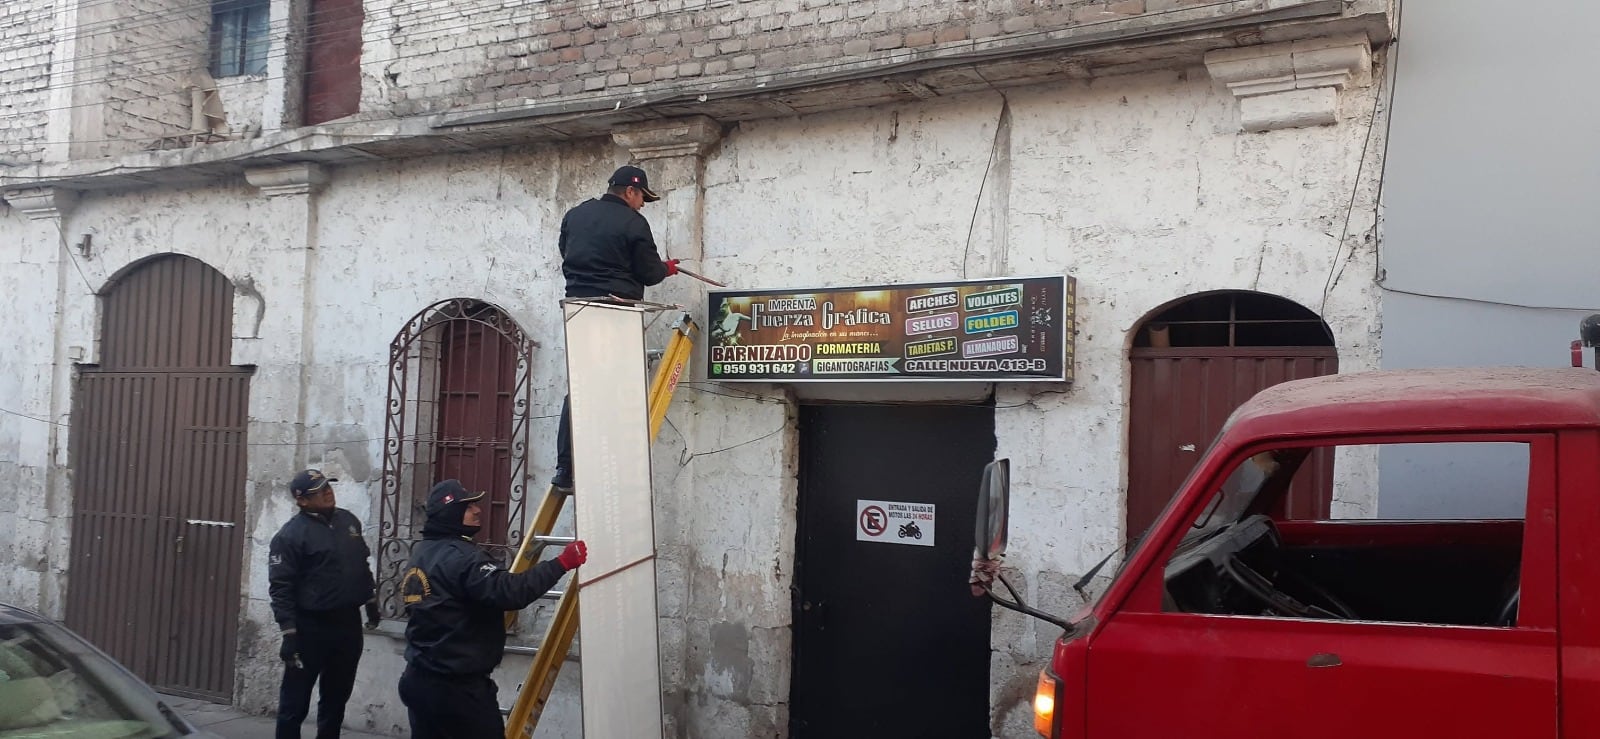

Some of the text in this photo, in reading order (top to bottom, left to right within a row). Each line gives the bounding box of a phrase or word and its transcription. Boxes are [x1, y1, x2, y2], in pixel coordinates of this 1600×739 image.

[769, 297, 816, 311] IMPRENTA
[909, 293, 957, 310] AFICHES
[967, 291, 1018, 308] VOLANTES
[751, 303, 814, 331] Fuerza
[912, 317, 952, 332] SELLOS
[967, 314, 1016, 330] FOLDER
[1065, 281, 1075, 379] IMPRENTA
[711, 344, 811, 363] BARNIZADO
[816, 343, 881, 355] FORMATERIA
[908, 341, 946, 356] TARJETAS
[966, 338, 1016, 355] ALMANAQUES
[723, 363, 795, 374] 959 931 642
[817, 360, 889, 372] GIGANTOGRAFIAS
[905, 358, 1046, 373] CALLE NUEVA 413-B
[888, 511, 903, 519] MOTOS
[912, 505, 926, 513] SALIDA
